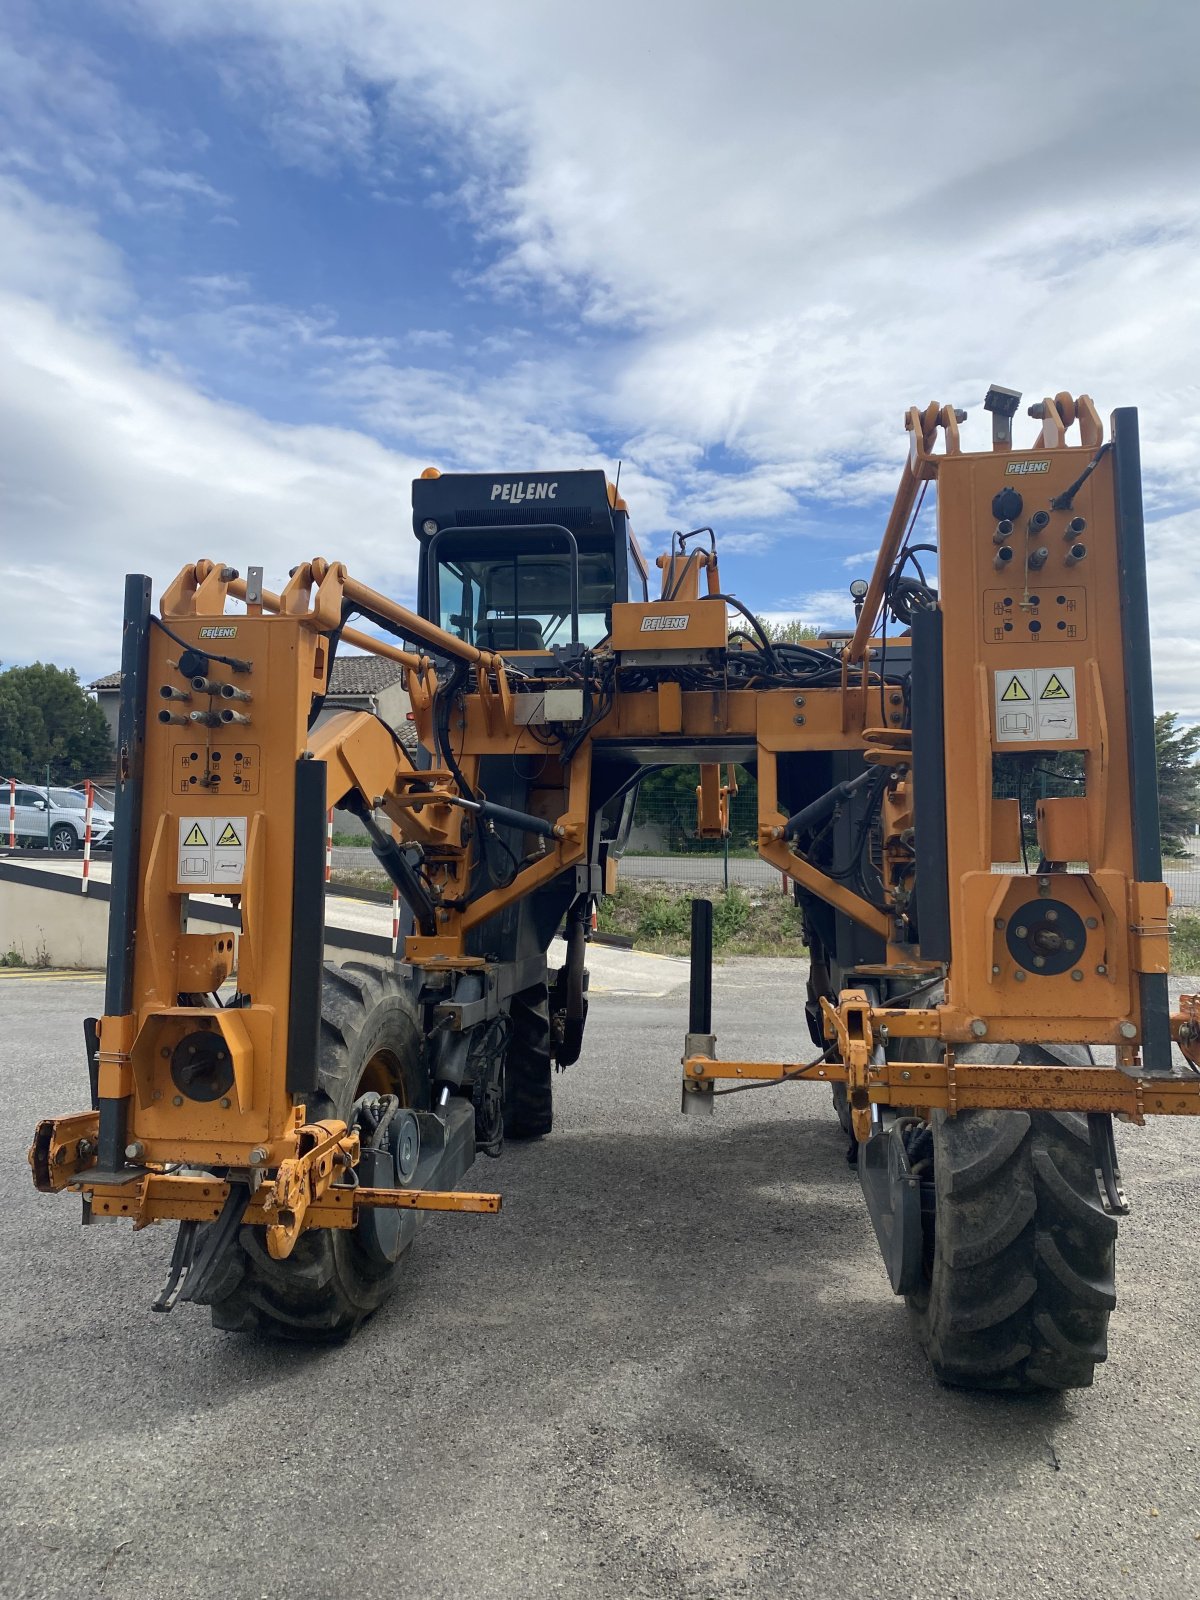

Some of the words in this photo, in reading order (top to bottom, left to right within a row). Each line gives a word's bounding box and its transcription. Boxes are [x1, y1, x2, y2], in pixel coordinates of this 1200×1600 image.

[1008, 461, 1048, 474] PELLENC
[490, 481, 558, 503] PELLENC
[643, 616, 686, 631] PELLENC
[201, 626, 236, 639] PELLENC
